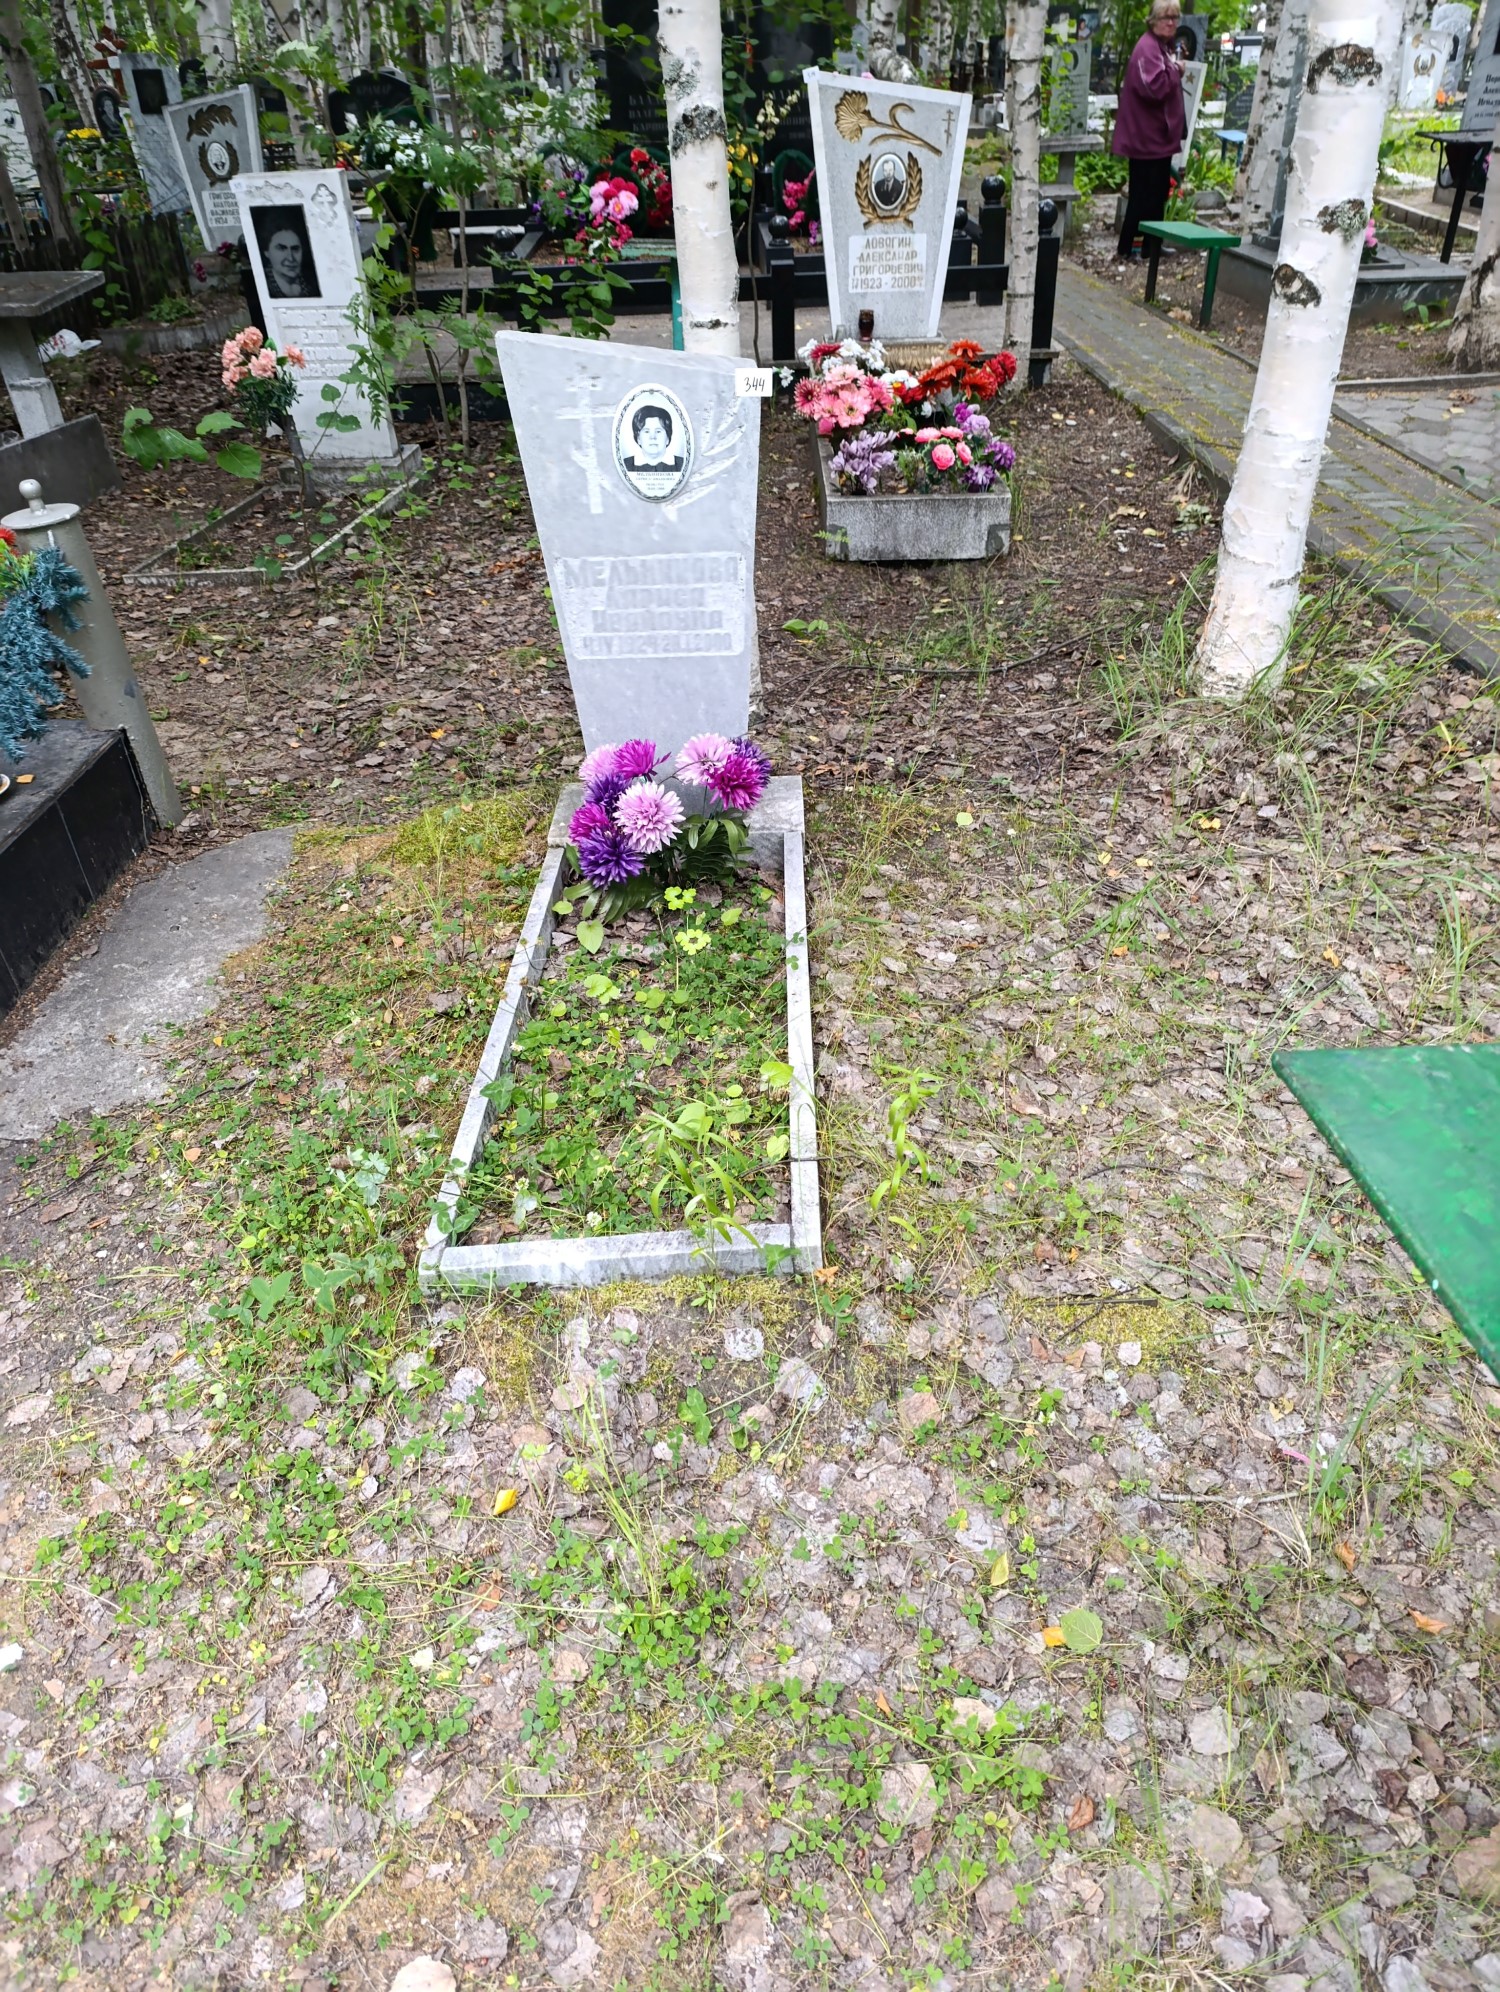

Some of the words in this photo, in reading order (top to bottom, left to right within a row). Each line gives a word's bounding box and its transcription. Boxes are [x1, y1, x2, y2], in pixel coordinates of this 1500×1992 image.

[865, 236, 911, 249] ЛОВЯГИН
[858, 250, 918, 263] АЛЕКСАНДР
[853, 263, 923, 277] ГРИГОРЬЕВИЧ
[891, 276, 917, 289] 2000
[744, 376, 765, 392] 344
